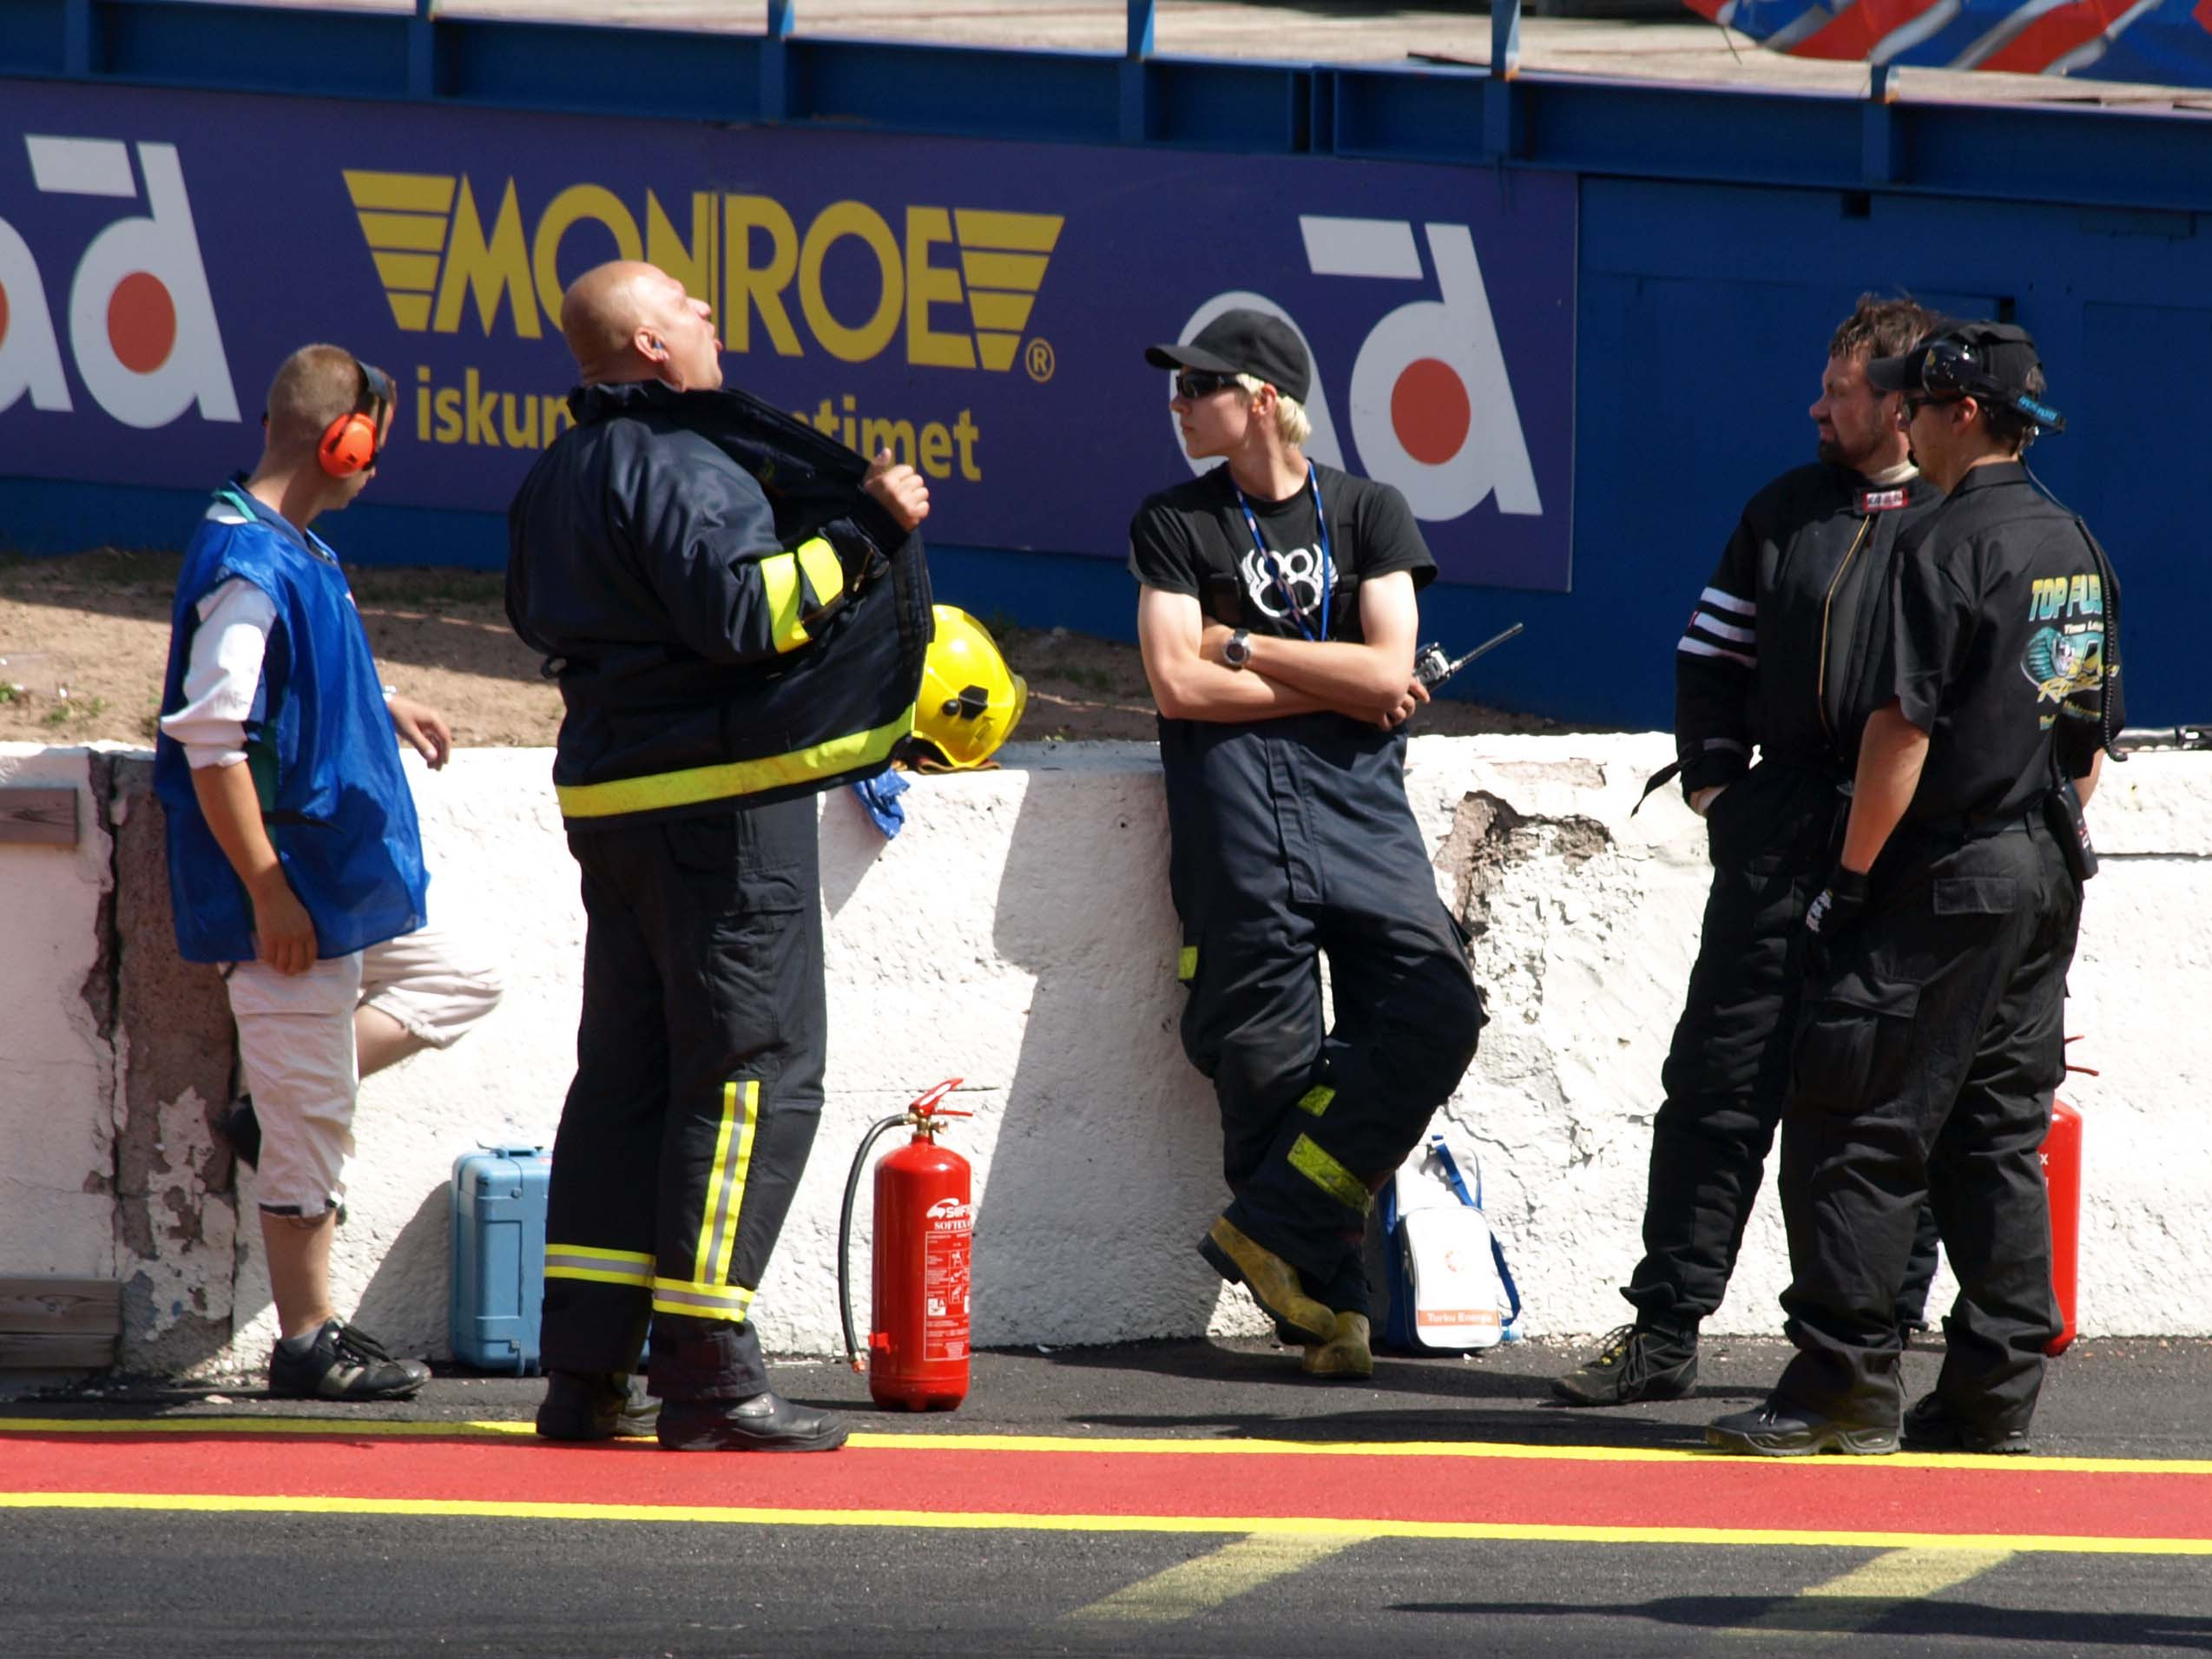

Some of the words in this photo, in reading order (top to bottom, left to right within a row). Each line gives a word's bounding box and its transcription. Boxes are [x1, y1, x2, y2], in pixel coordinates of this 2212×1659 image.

[434, 173, 977, 369] MONROE
[2029, 576, 2068, 622] TOP
[2066, 573, 2103, 618] FUE
